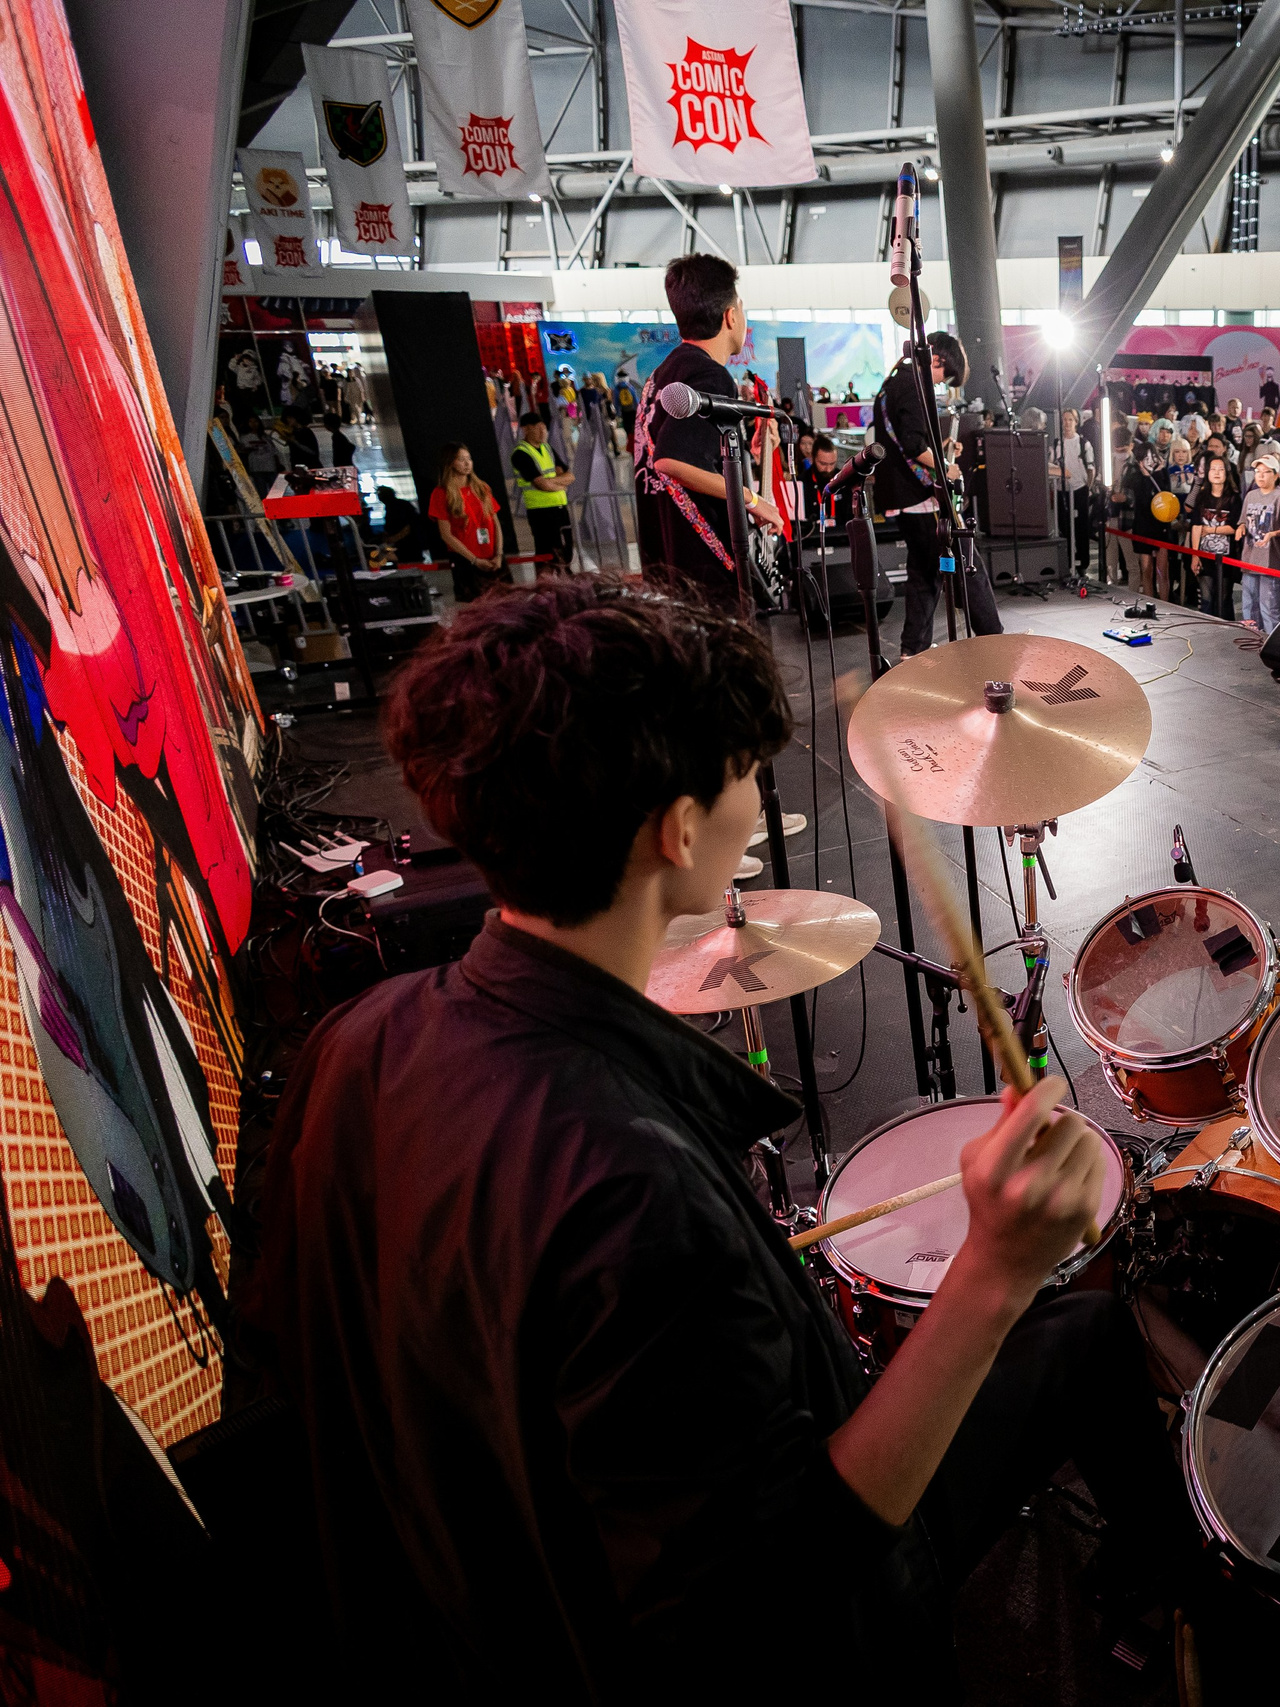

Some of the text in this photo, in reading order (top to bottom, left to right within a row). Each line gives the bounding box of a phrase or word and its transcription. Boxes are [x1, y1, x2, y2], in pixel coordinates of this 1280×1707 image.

[681, 93, 750, 143] CON
[468, 143, 511, 171] CON
[260, 208, 305, 218] AKI TIME
[360, 222, 390, 240] CON
[279, 251, 302, 265] CON
[1020, 664, 1101, 706] K
[914, 753, 945, 773] Dark
[698, 950, 780, 993] K
